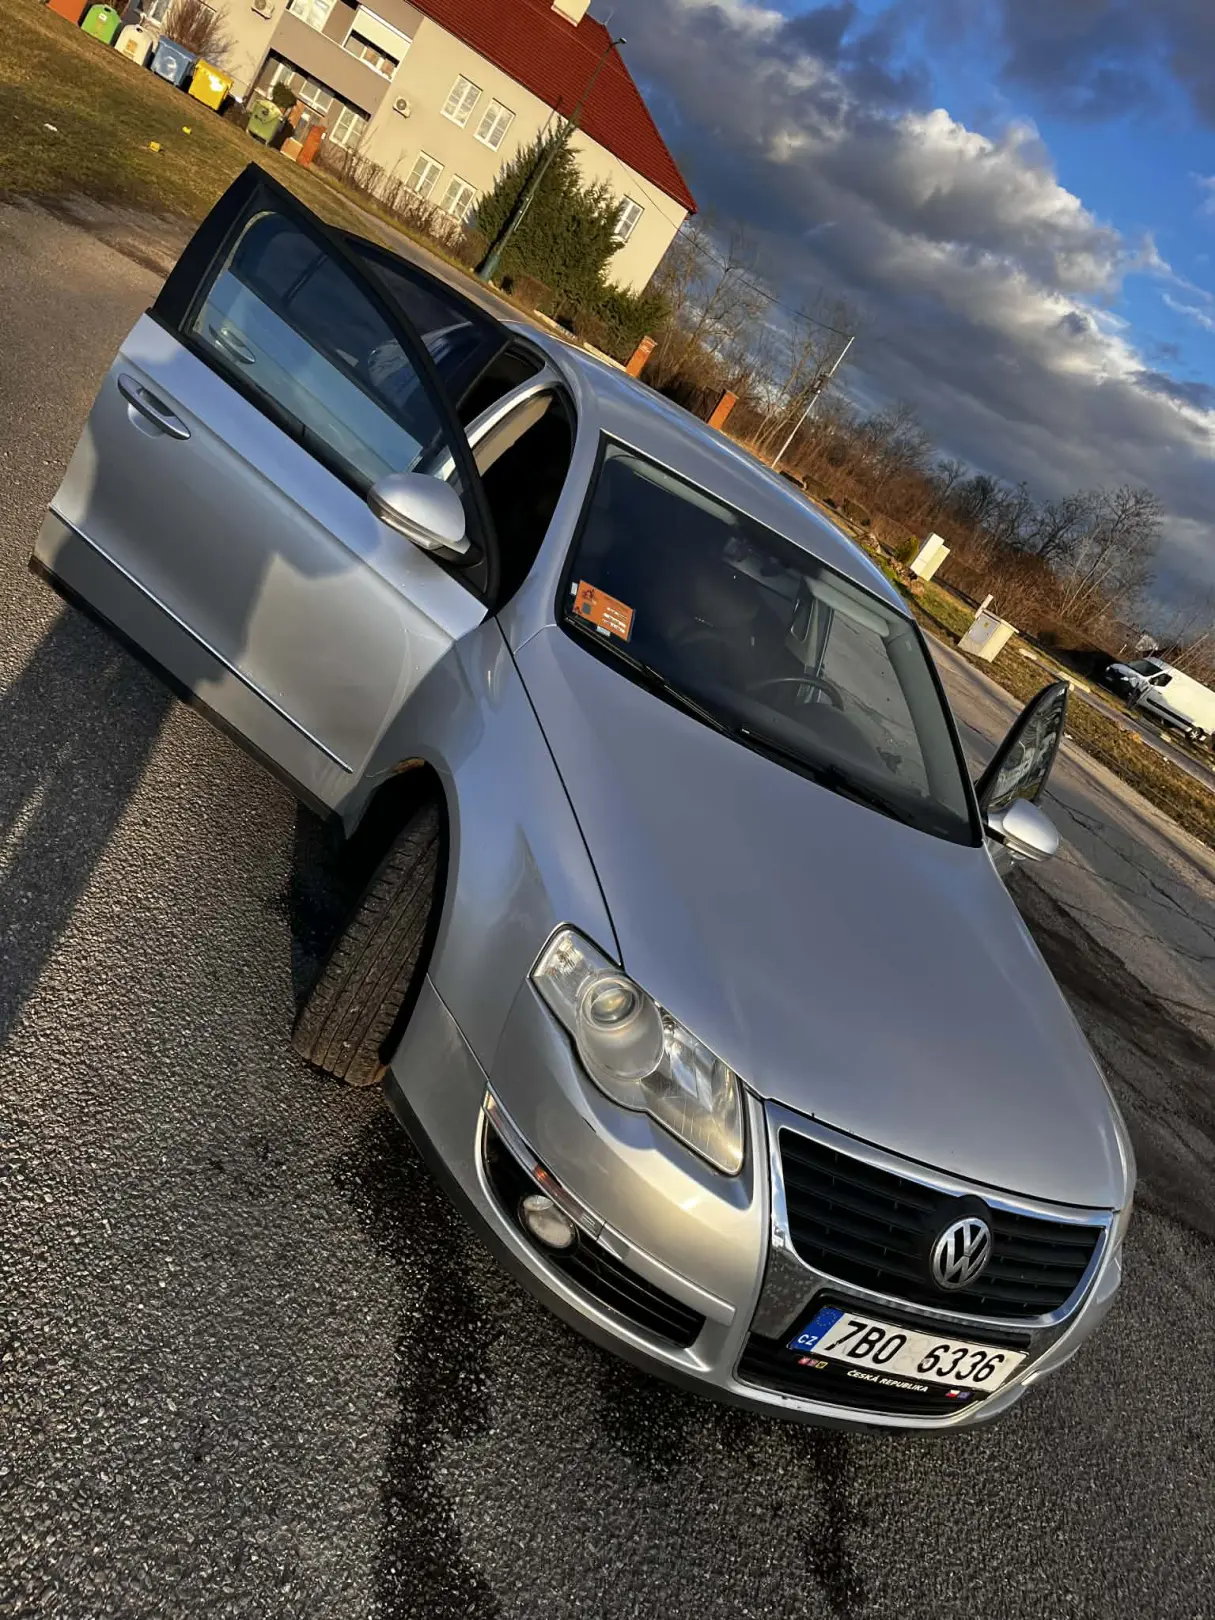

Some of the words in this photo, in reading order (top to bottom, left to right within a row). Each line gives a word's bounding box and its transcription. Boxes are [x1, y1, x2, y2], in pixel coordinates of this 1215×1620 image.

[797, 1334, 818, 1346] CZ
[825, 1321, 907, 1364] 7B0
[917, 1344, 1005, 1382] 6336
[846, 1369, 880, 1383] ČESKÁ
[879, 1378, 929, 1393] REPUBLIKA
